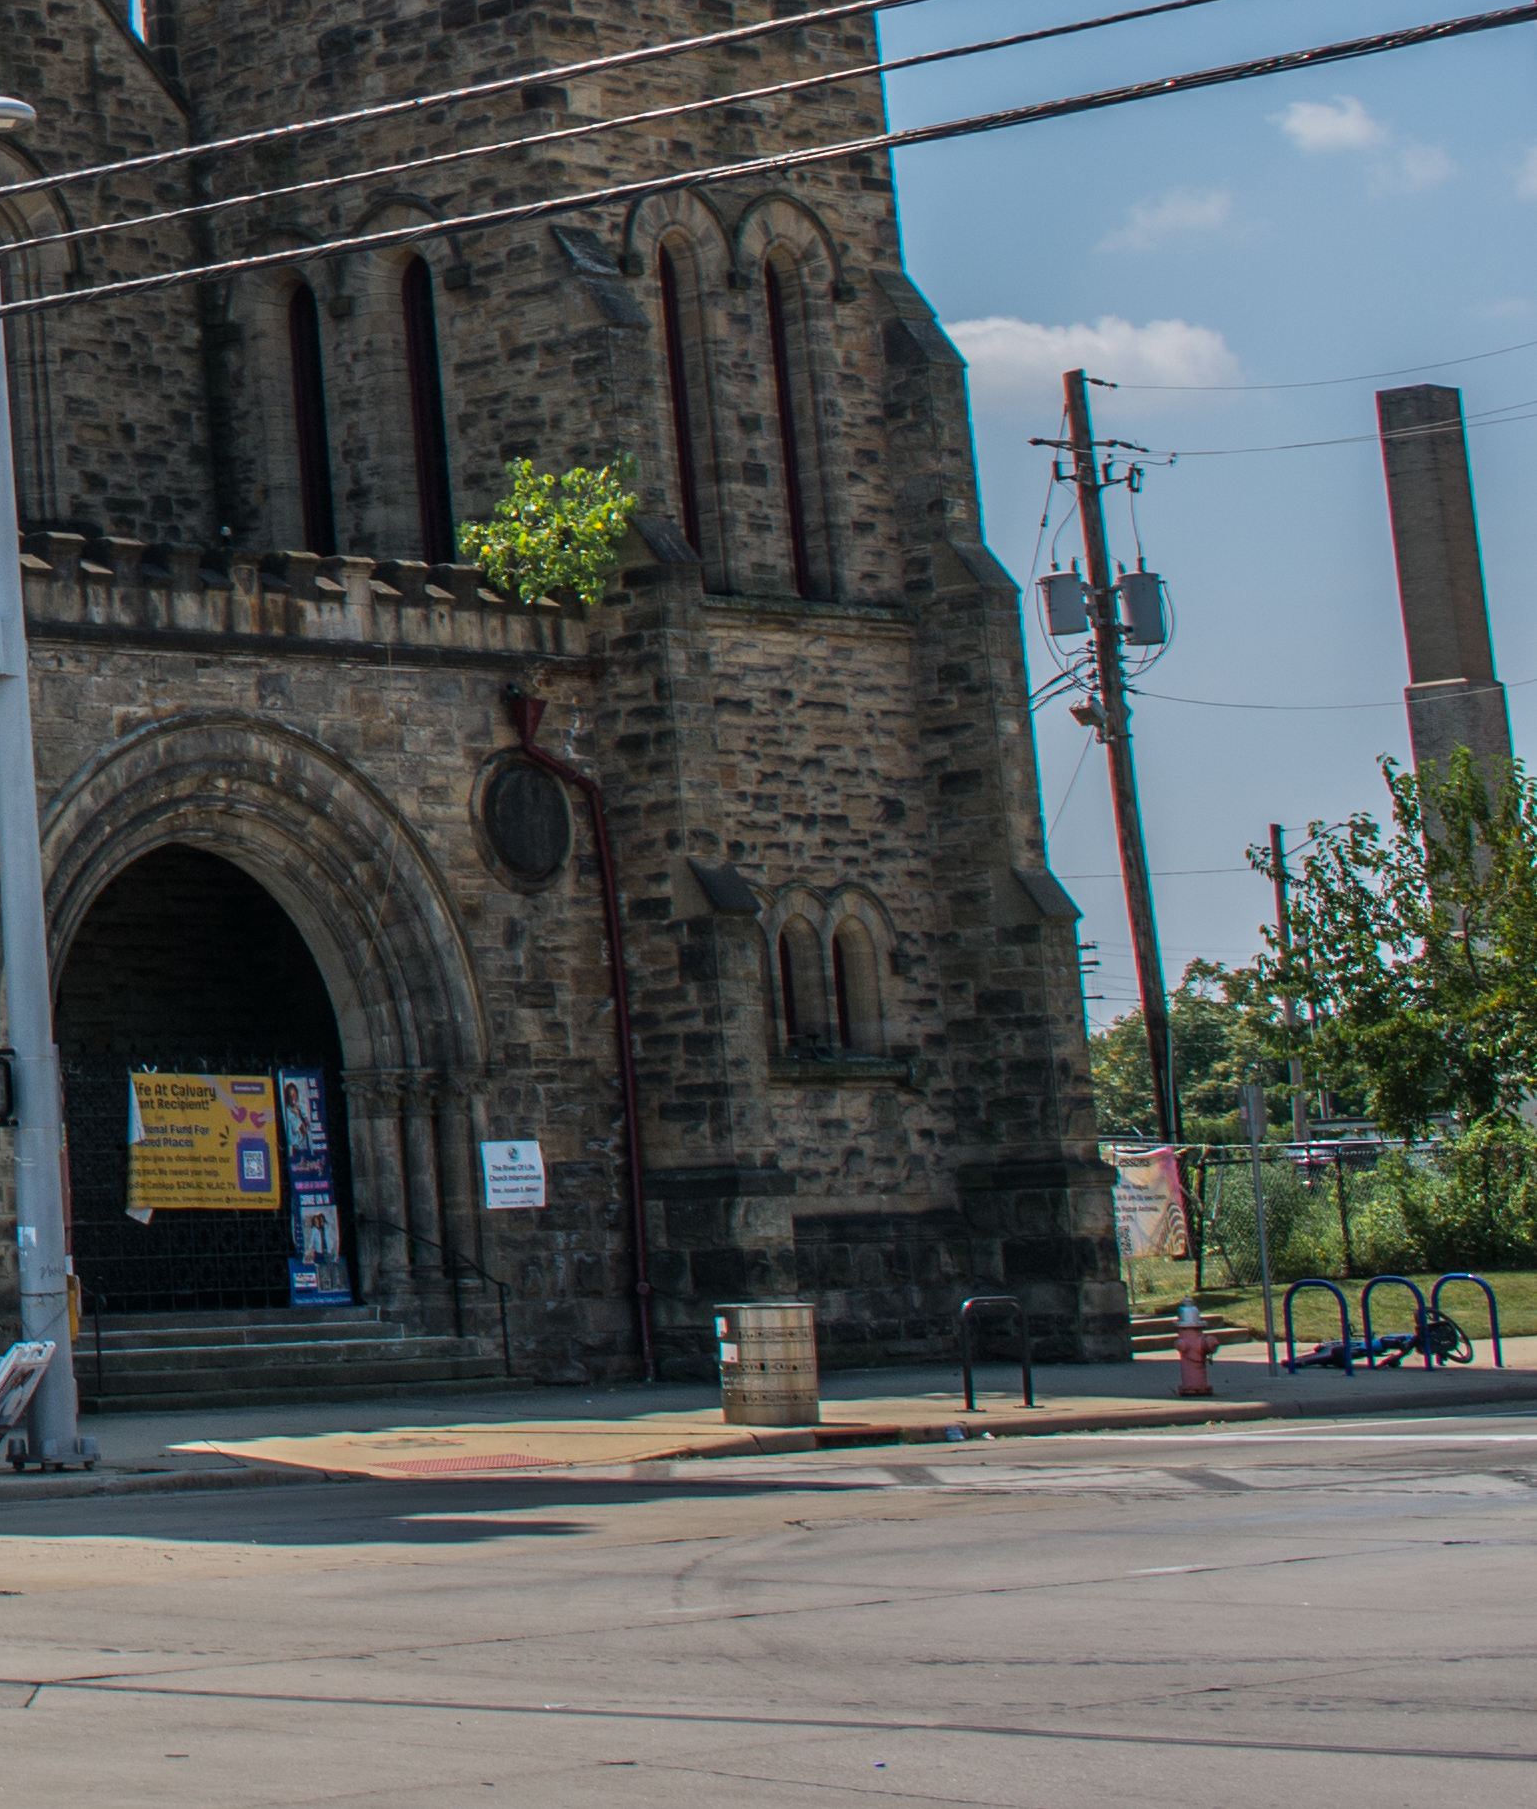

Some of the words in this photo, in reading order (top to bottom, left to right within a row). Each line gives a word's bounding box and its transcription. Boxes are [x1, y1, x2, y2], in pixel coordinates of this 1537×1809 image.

[154, 1083, 168, 1097] At
[170, 1084, 217, 1102] Calvary
[170, 1125, 193, 1135] Fund
[194, 1125, 210, 1136] For
[163, 1137, 195, 1148] Places
